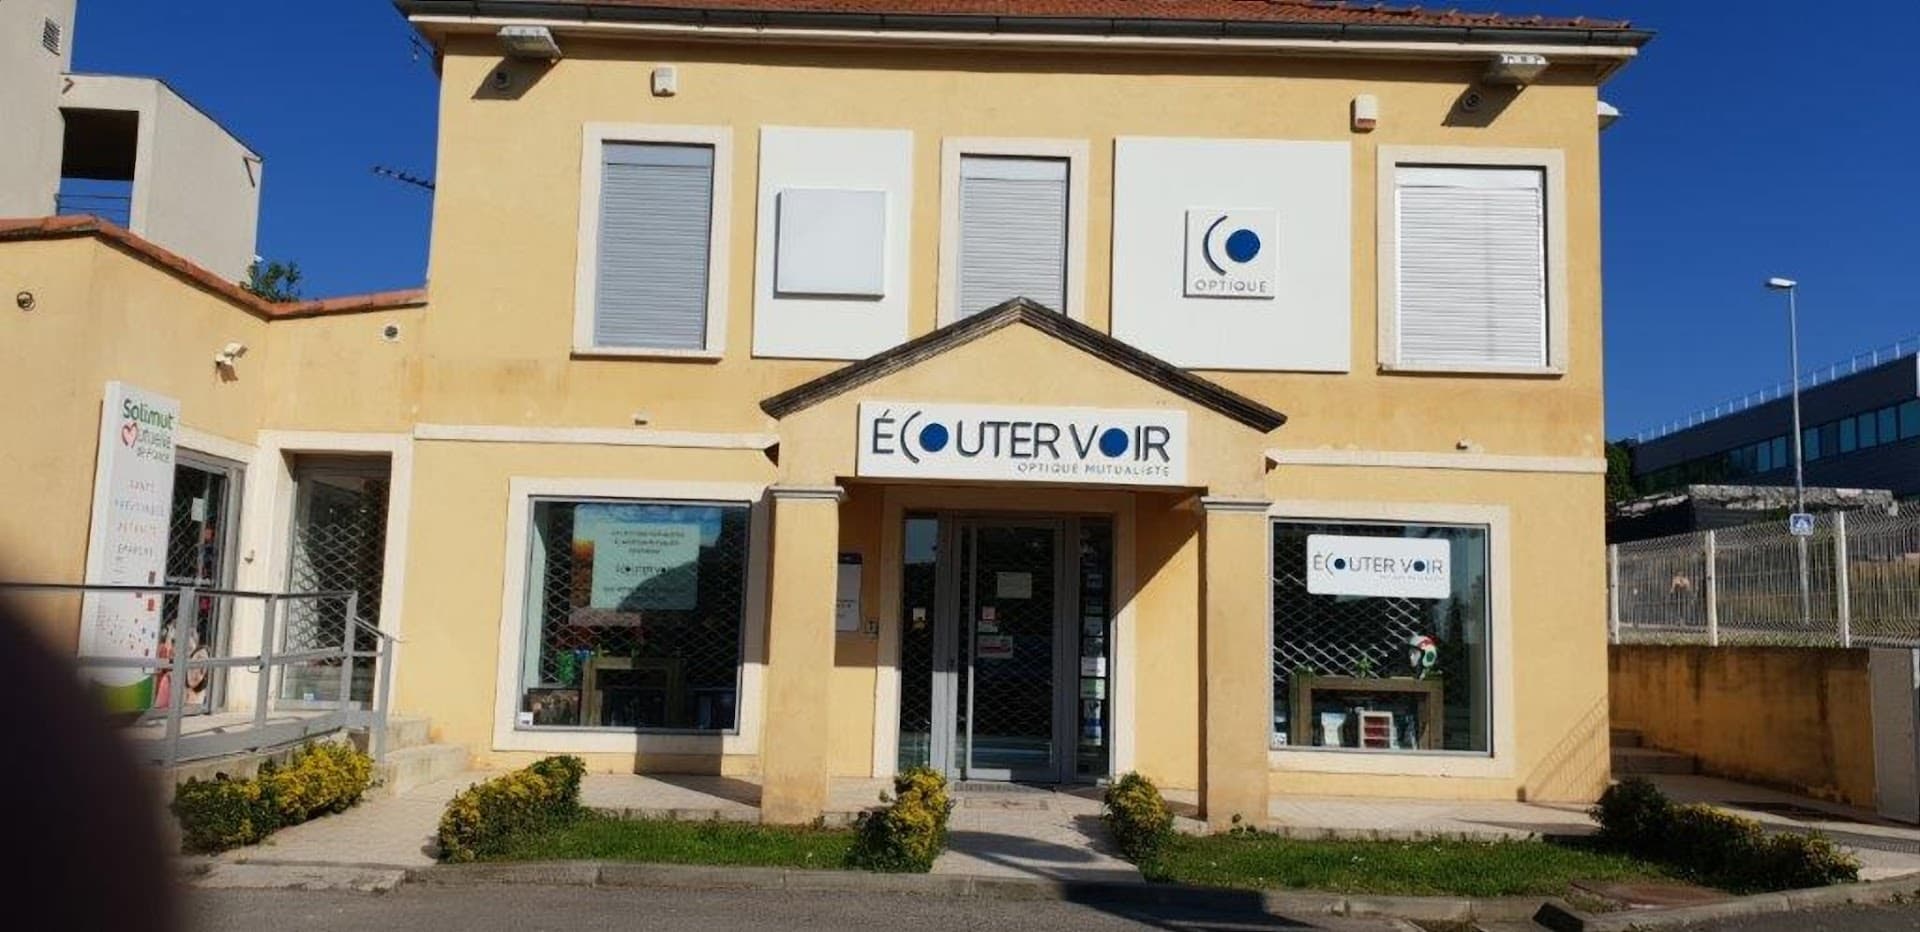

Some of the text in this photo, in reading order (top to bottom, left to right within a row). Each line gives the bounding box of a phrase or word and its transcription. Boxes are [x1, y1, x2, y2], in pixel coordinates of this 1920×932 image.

[1194, 279, 1267, 294] OPTIQUE
[123, 398, 175, 430] Solimut
[872, 409, 1171, 464] ÉCOUTER VOIR
[1017, 462, 1170, 478] OPTIQUE MUTUALISTE
[1313, 551, 1443, 576] ÉCOUTER VOIR
